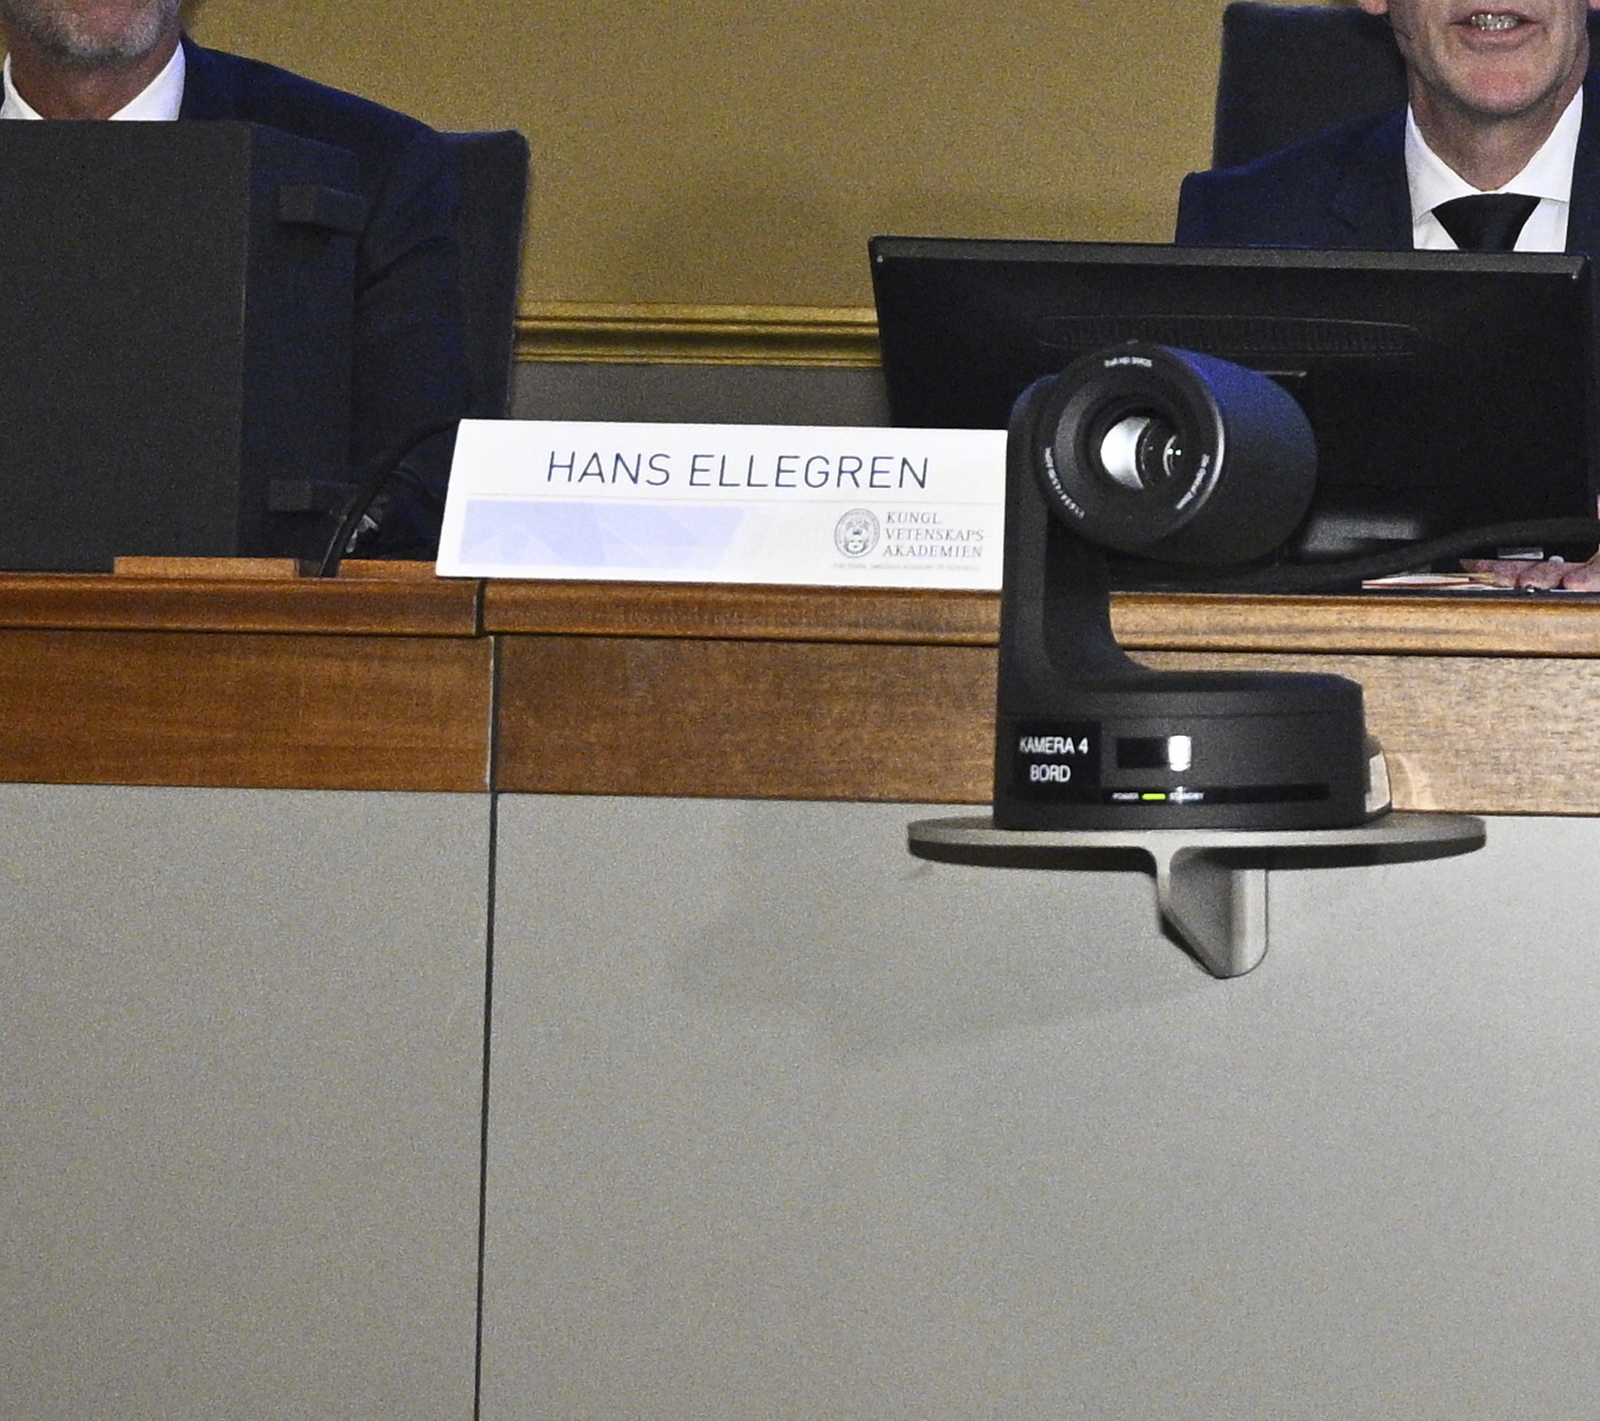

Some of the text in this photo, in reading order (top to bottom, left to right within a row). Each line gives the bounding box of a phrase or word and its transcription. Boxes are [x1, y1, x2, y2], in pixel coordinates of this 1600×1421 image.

[547, 451, 928, 489] HANS ELLEGREN
[1019, 736, 1089, 754] KAMERA 4
[1029, 764, 1071, 782] BORD
